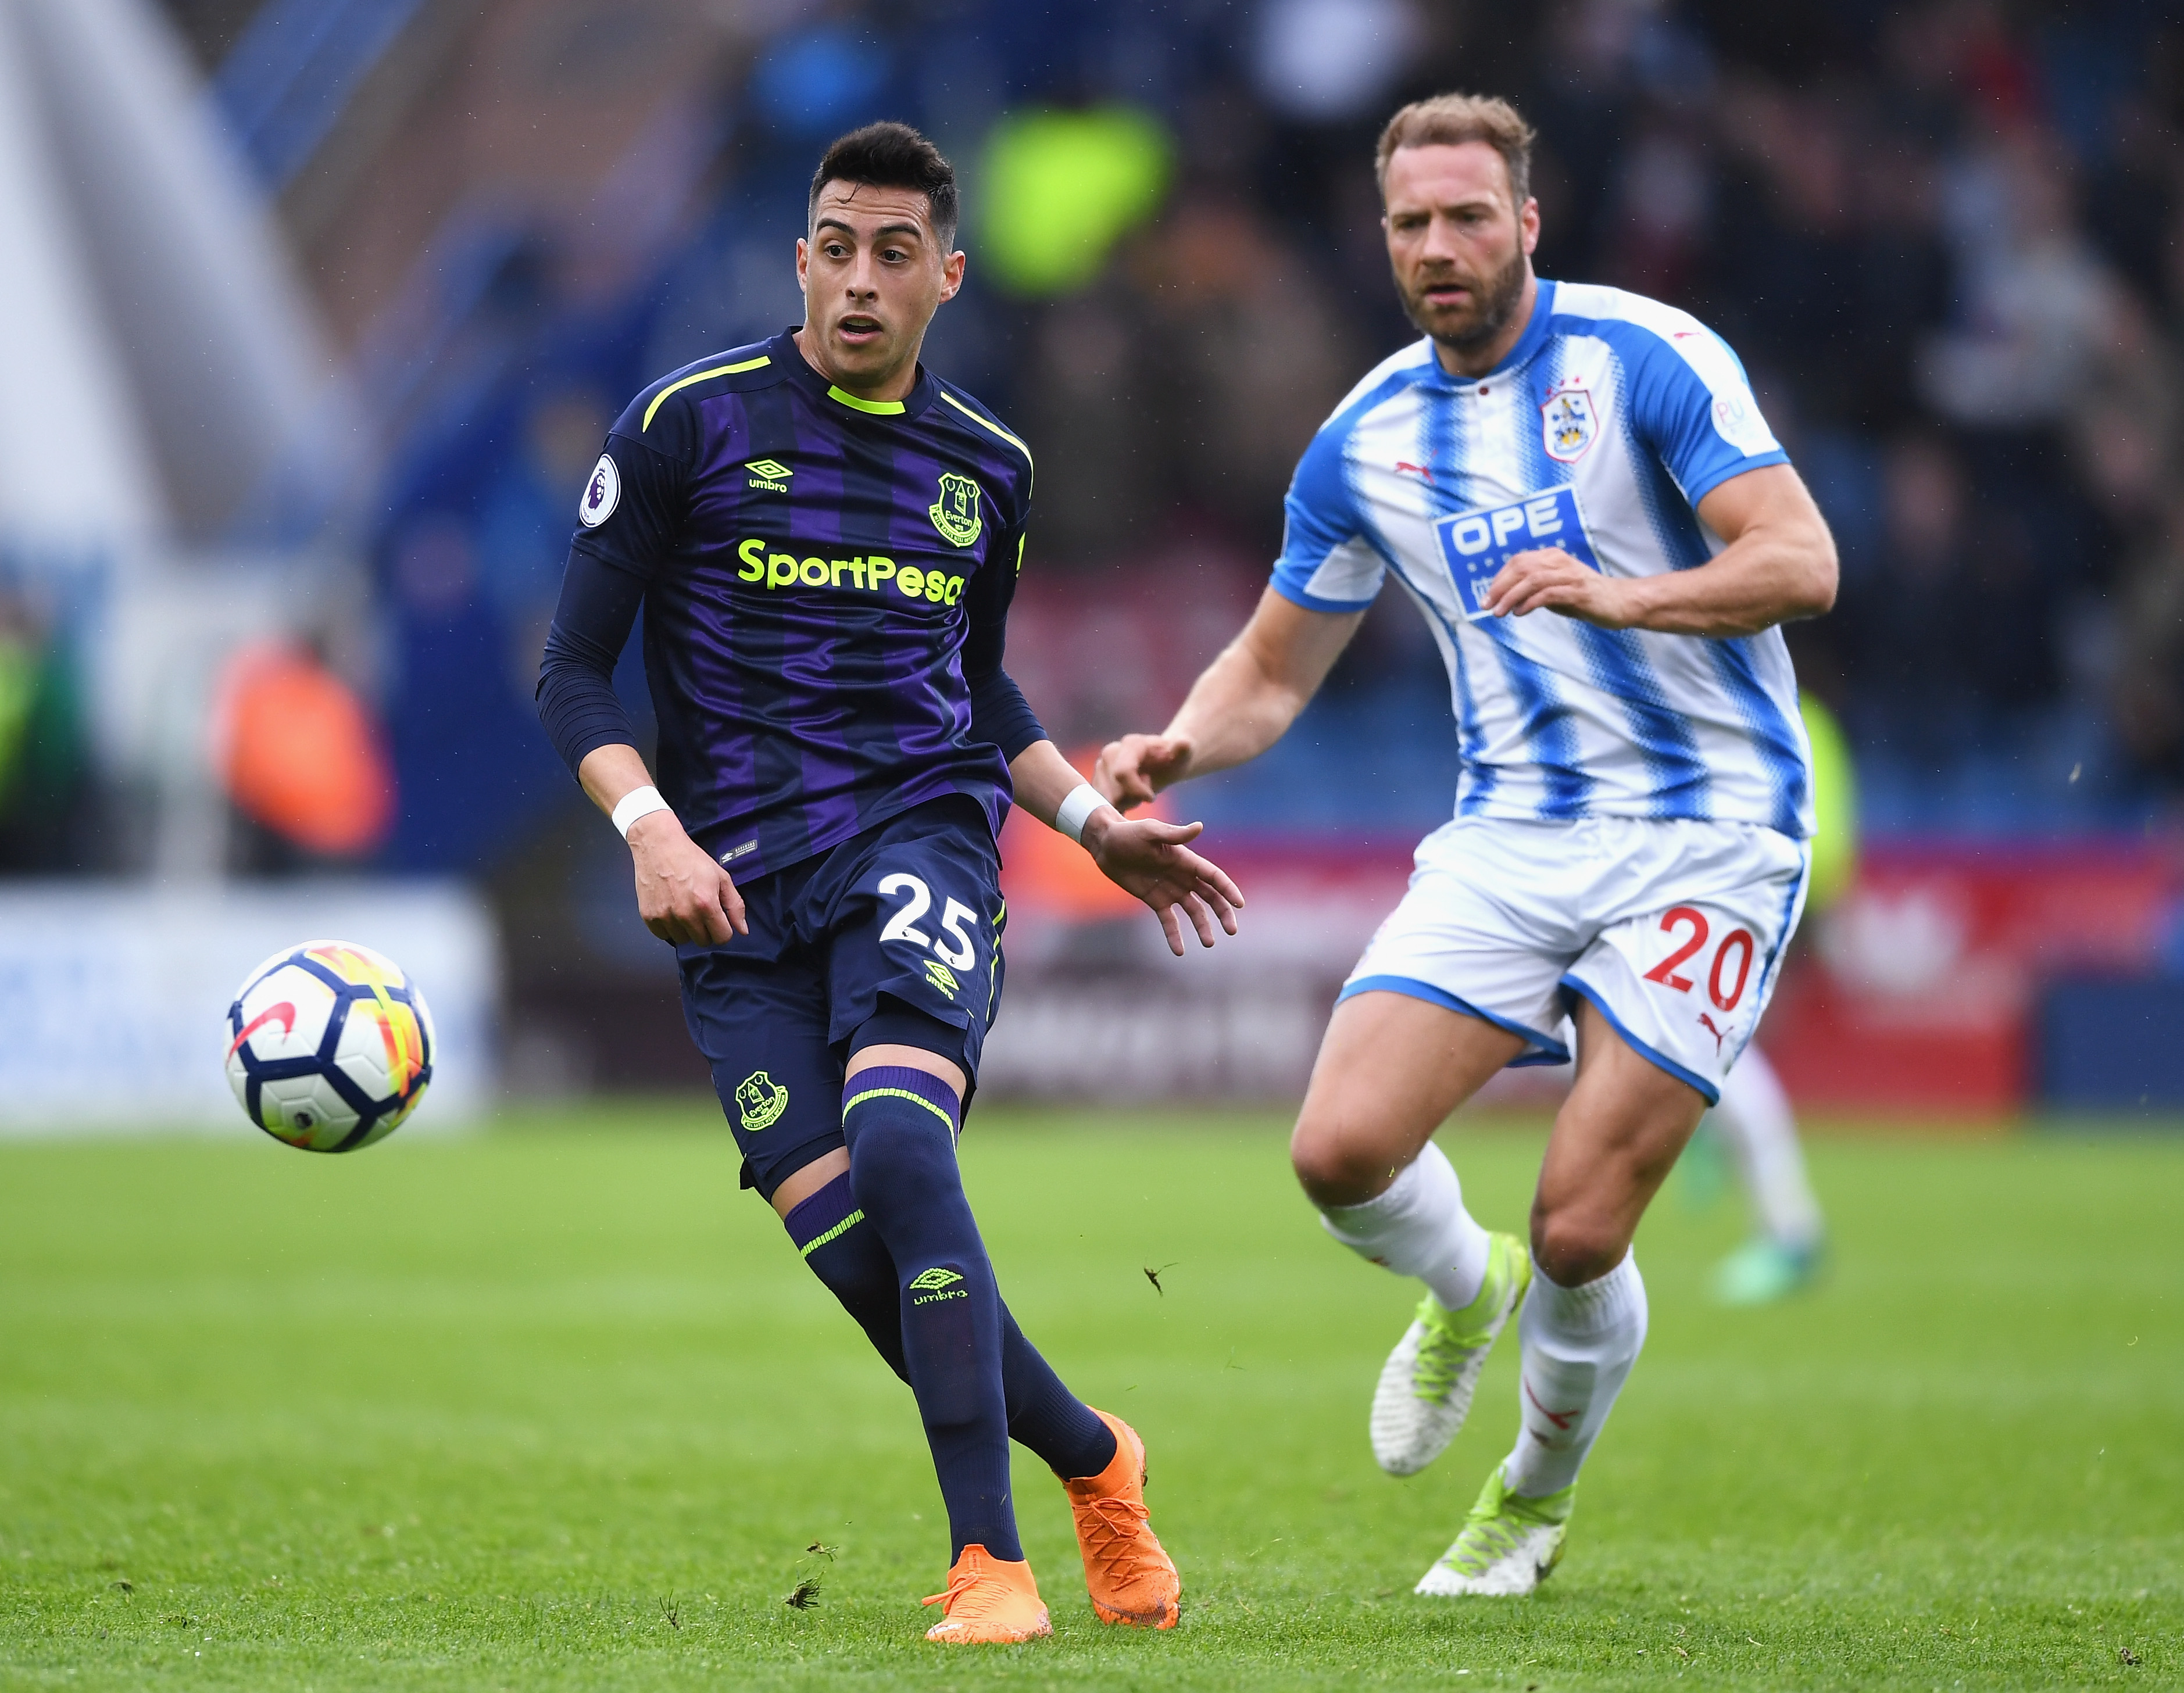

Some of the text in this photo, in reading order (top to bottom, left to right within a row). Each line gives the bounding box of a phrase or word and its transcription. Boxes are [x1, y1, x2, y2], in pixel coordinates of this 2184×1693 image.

[749, 479, 787, 493] umbro
[945, 510, 973, 527] Everton
[1452, 496, 1564, 556] OPE
[738, 539, 965, 606] SportPesa
[878, 872, 978, 971] 25
[1642, 907, 1754, 1012] 20
[925, 973, 954, 1001] umbro
[749, 1096, 775, 1118] Everton
[914, 1290, 968, 1305] umbro
